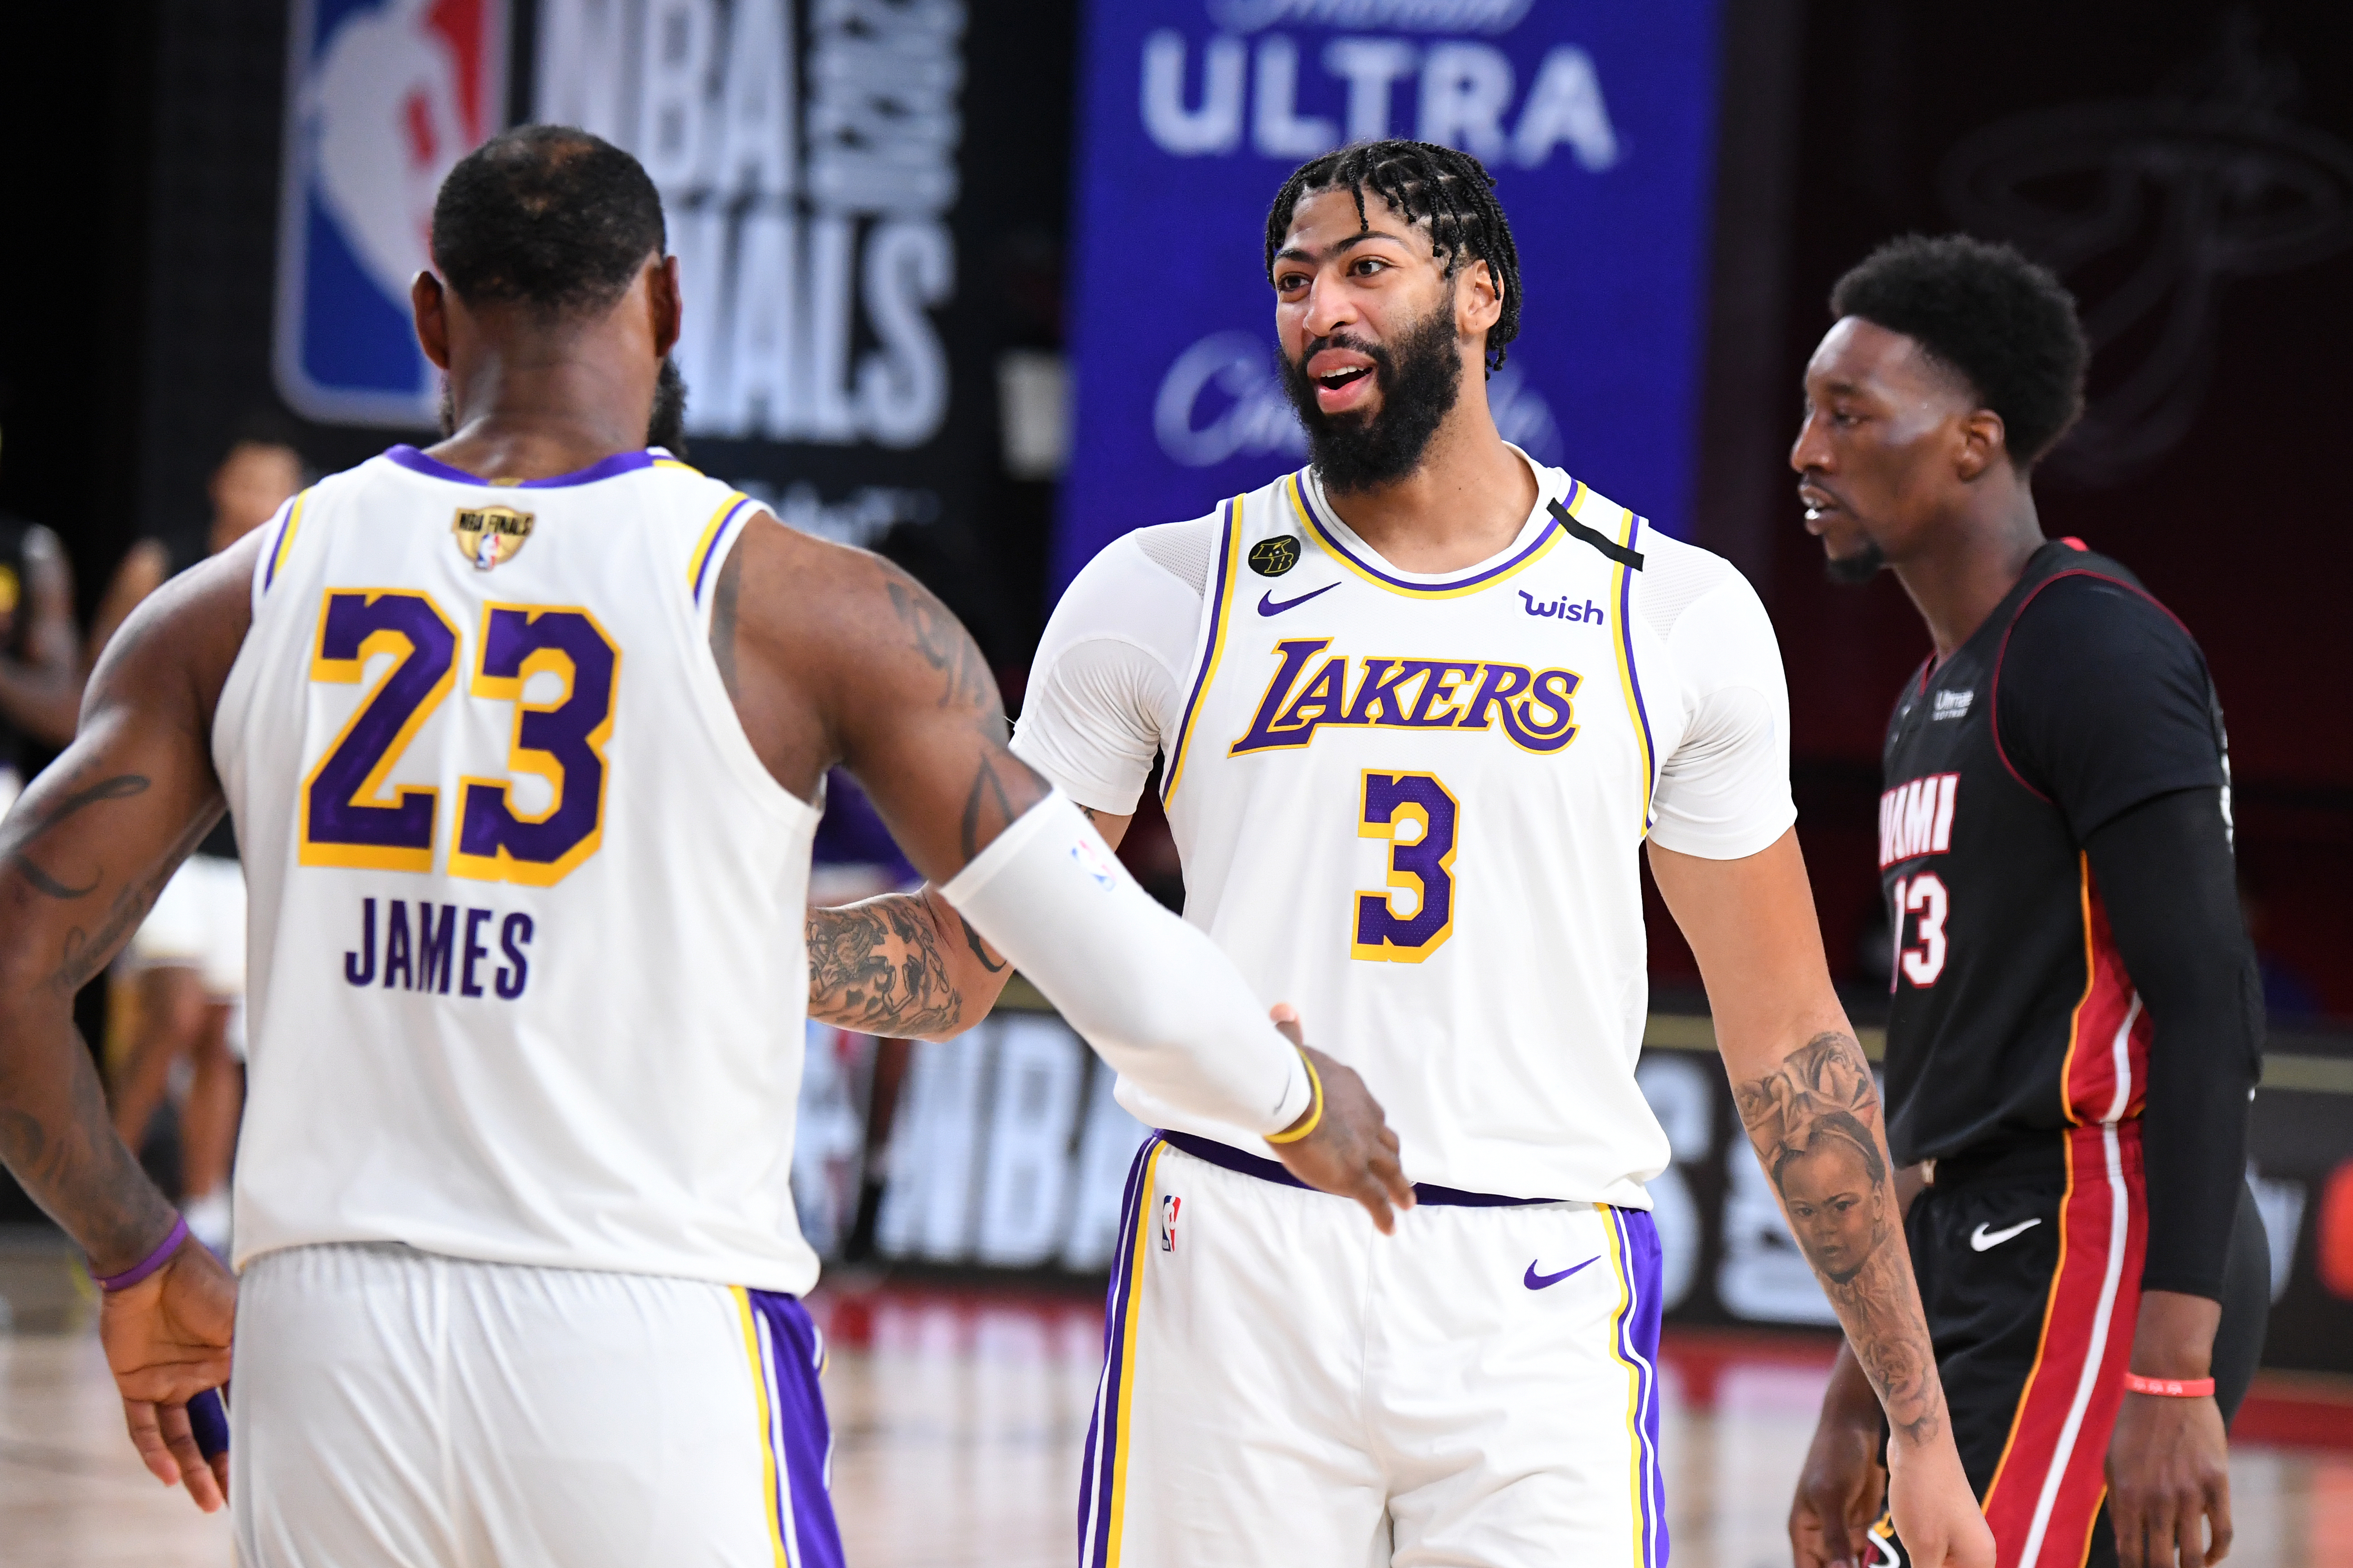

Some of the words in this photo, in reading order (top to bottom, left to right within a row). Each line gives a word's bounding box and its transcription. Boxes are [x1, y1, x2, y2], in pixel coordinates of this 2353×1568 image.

[531, 0, 800, 189] NBA
[1140, 28, 1620, 172] ULTRA
[1518, 589, 1604, 625] wish
[298, 587, 622, 888] 23
[1227, 637, 1584, 759] LAKERS
[1350, 768, 1461, 964] 3
[1889, 871, 1950, 995] 13
[344, 897, 535, 999] JAMES
